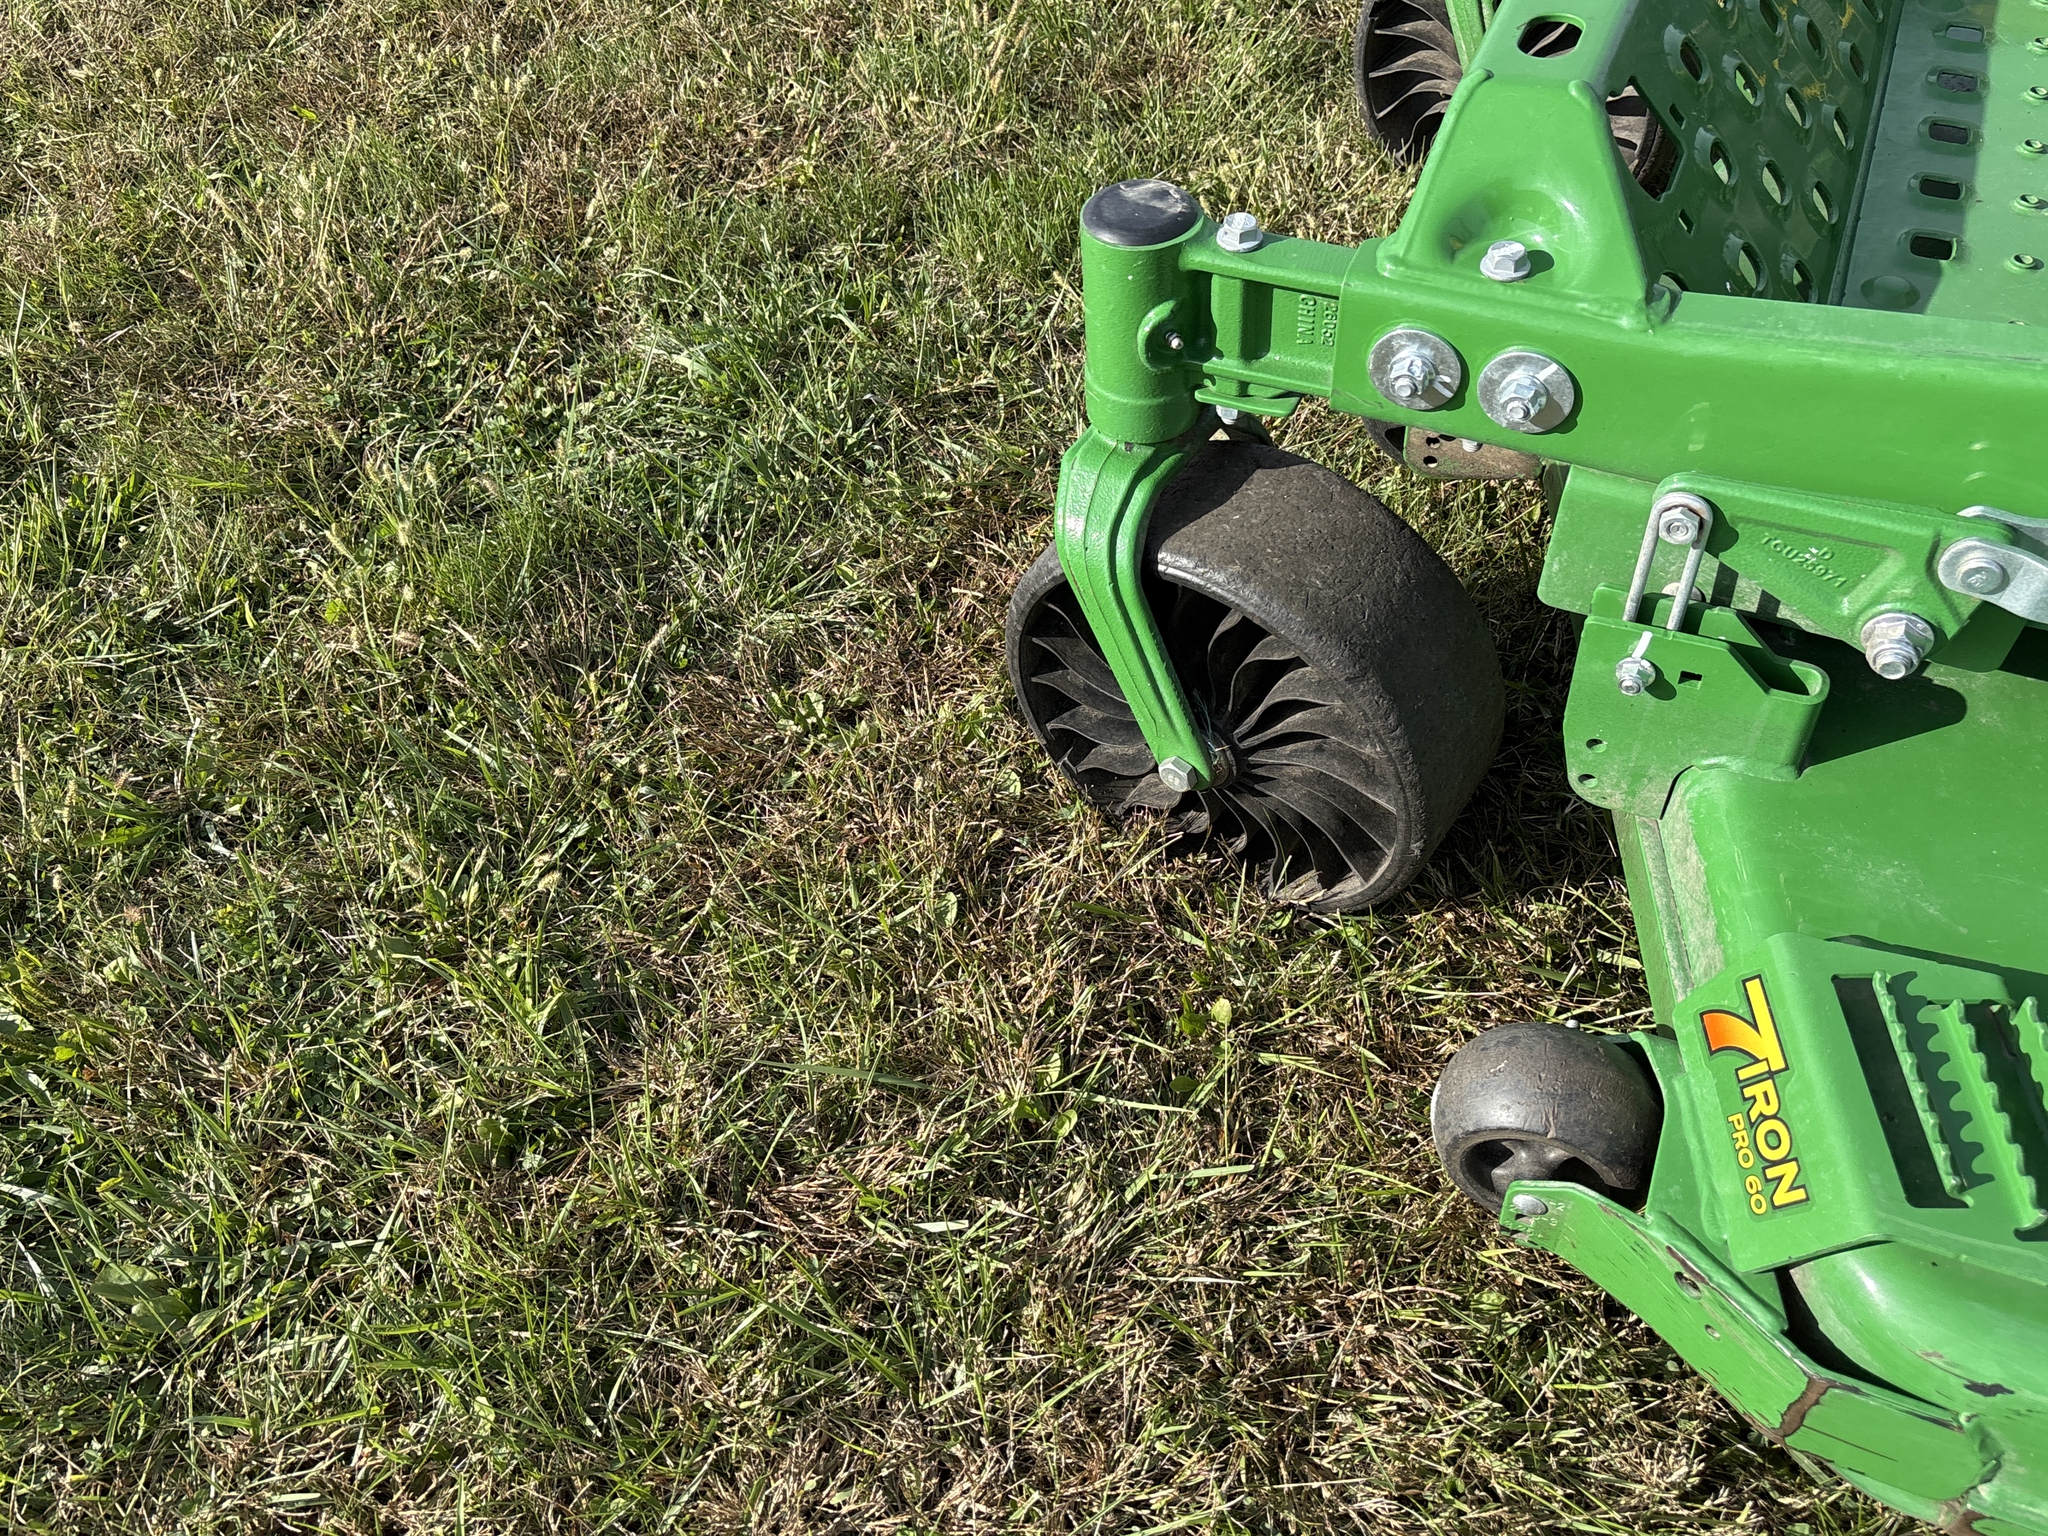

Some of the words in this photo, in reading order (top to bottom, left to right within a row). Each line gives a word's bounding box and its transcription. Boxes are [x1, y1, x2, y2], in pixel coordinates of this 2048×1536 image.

[1296, 294, 1317, 345] CHINA
[1727, 1112, 1755, 1169] PRO
[1745, 1175, 1768, 1216] 60
